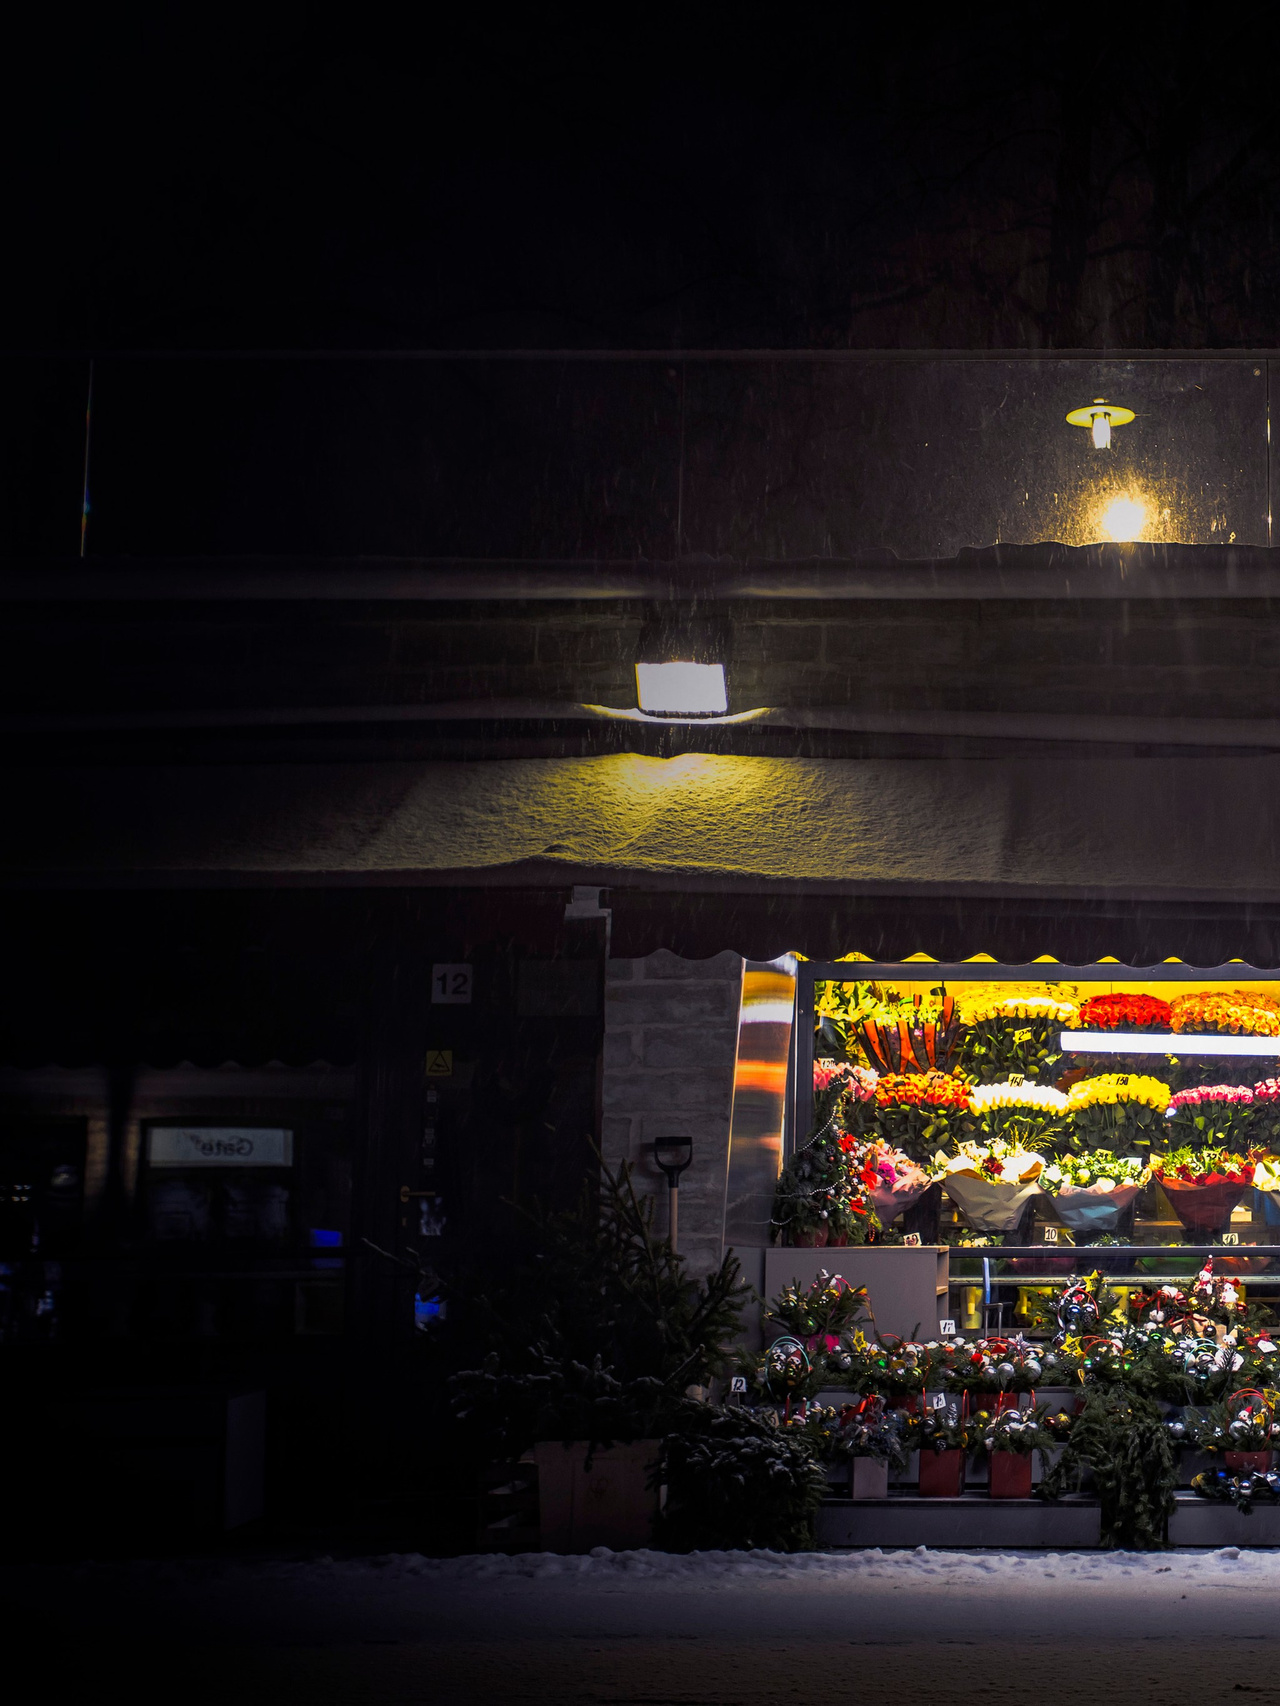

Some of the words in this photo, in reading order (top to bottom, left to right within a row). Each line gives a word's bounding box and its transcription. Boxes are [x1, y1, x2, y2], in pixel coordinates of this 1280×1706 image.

[436, 973, 468, 995] 12
[1046, 1229, 1056, 1240] 10
[733, 1379, 743, 1391] 12
